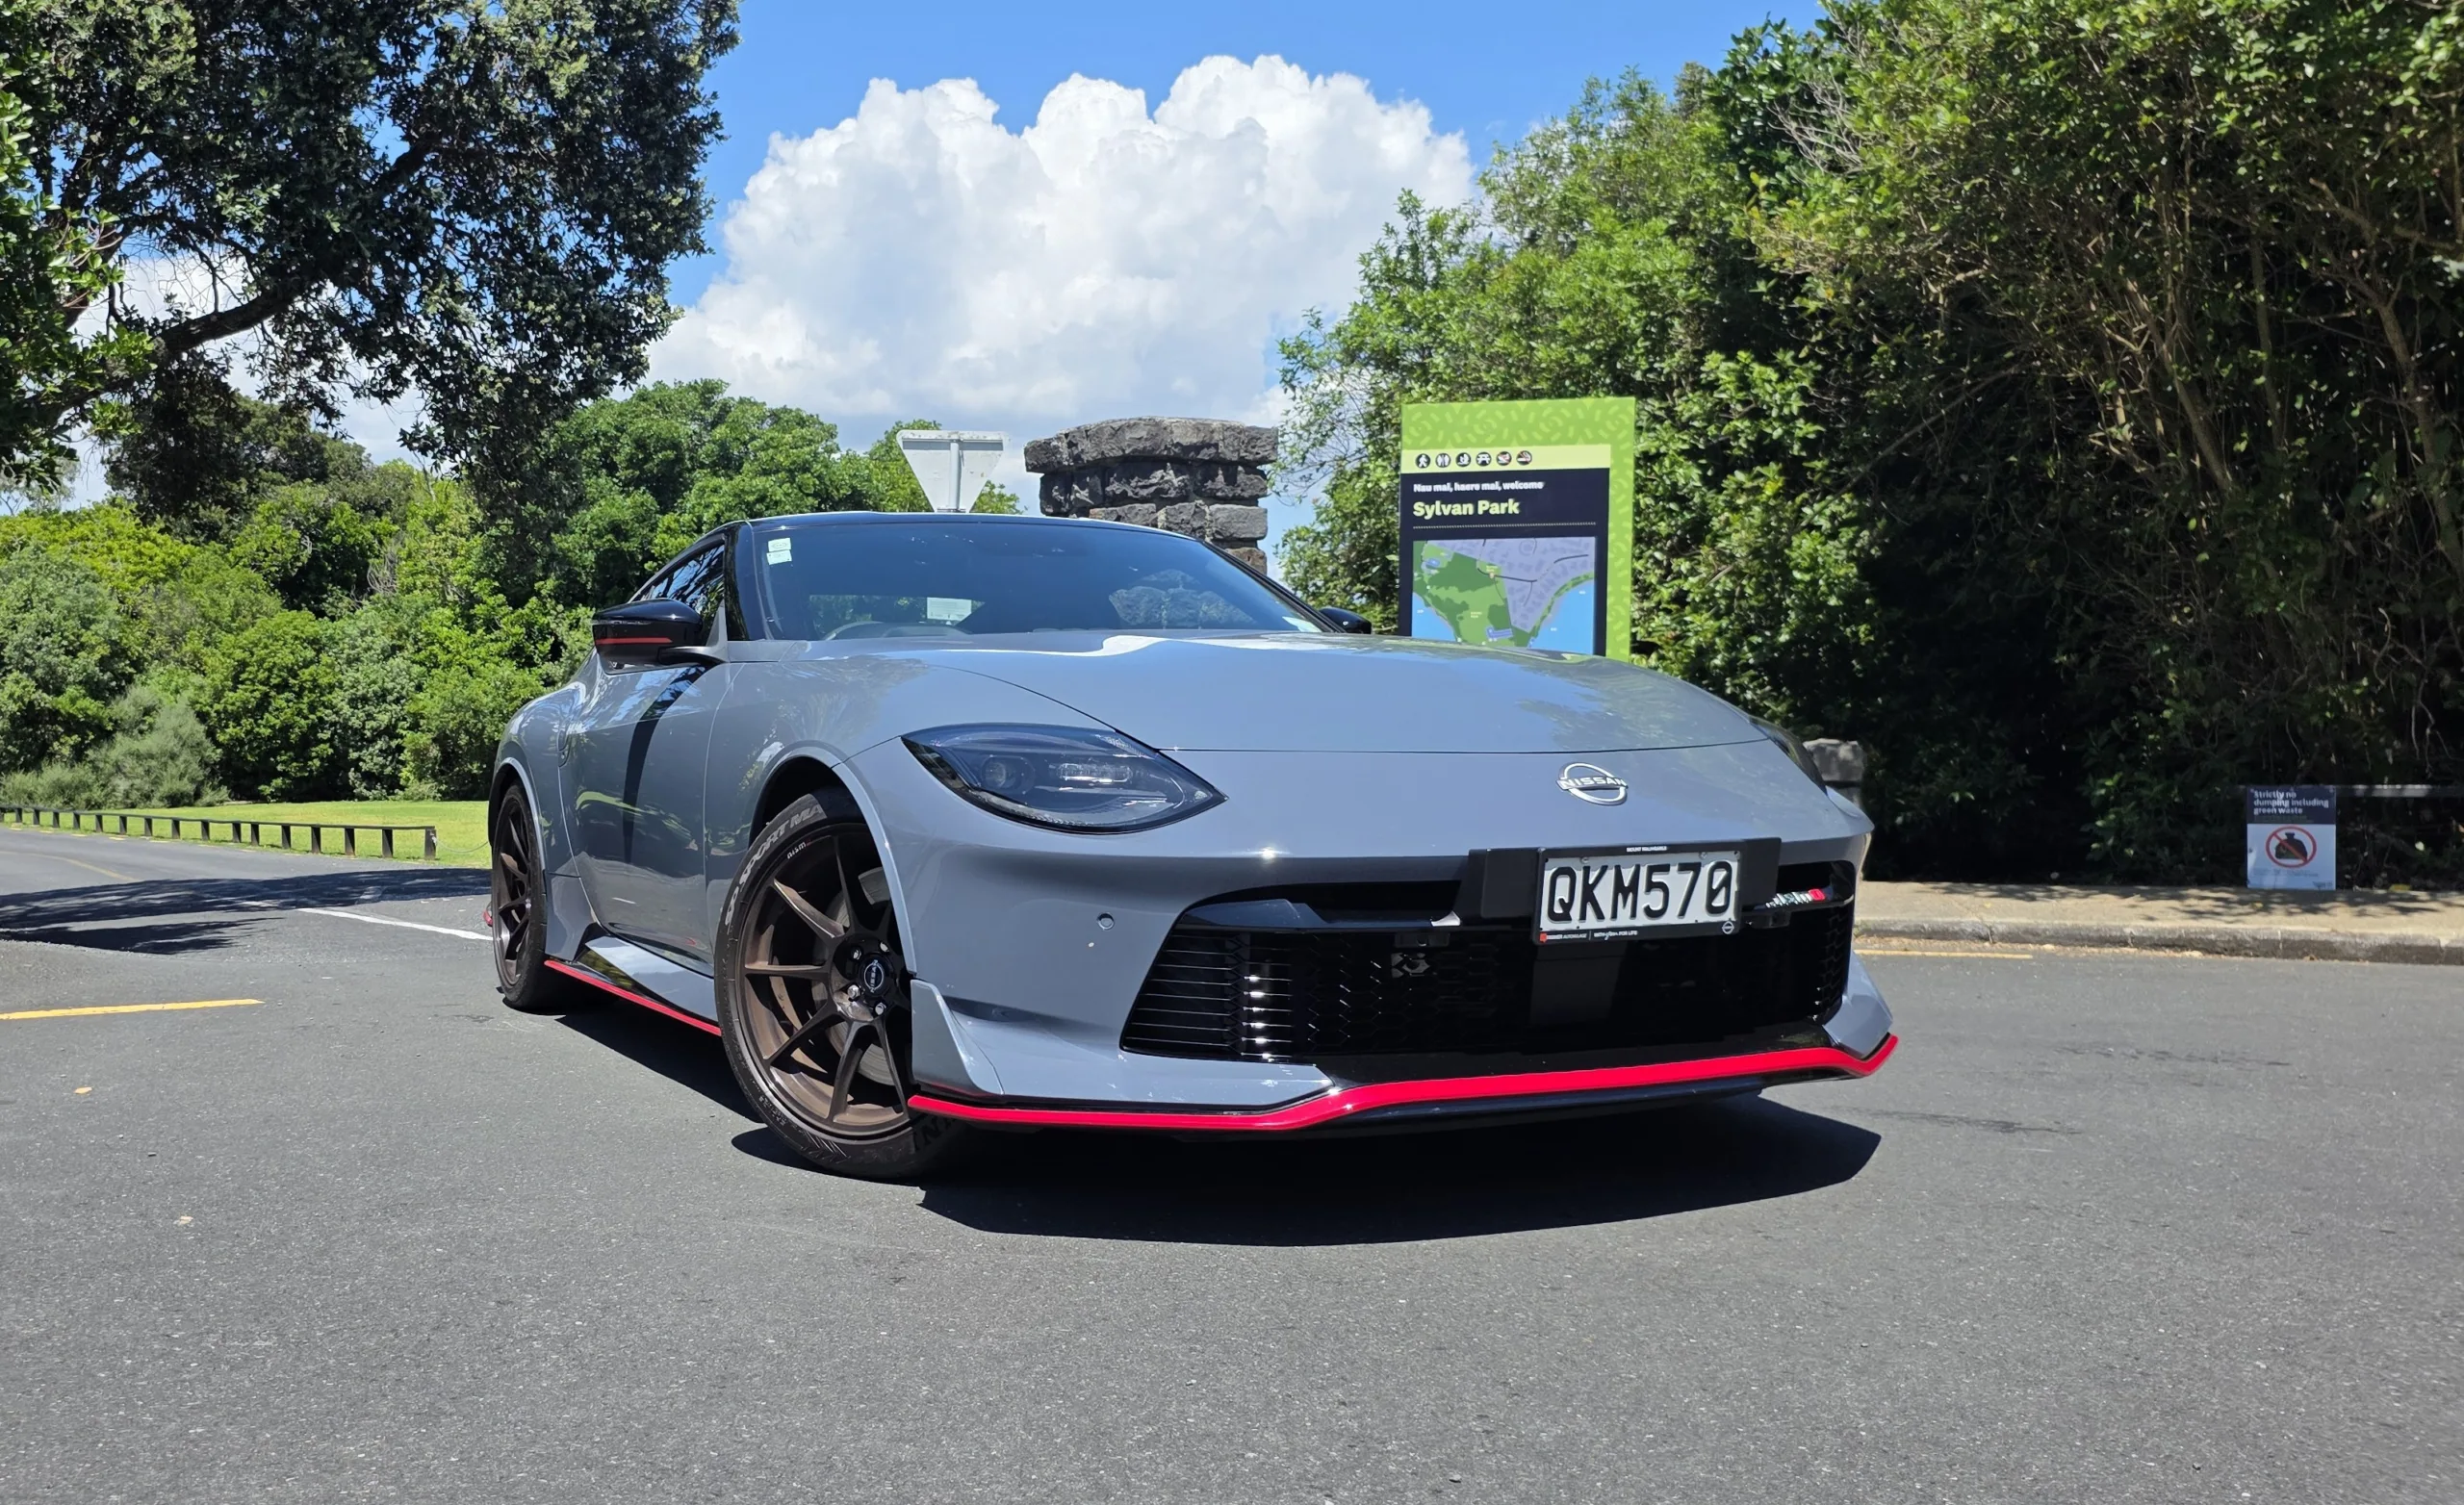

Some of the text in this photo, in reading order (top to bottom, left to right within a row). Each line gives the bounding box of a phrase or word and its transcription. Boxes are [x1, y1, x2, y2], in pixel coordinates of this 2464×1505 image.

[1413, 480, 1545, 493] Nau mai, haere mai, welcome
[1413, 498, 1520, 520] Sylvan Park
[2253, 790, 2284, 800] Strictly
[2253, 798, 2329, 808] dumping including
[739, 820, 789, 892] SPORT
[1547, 860, 1732, 923] QKM570
